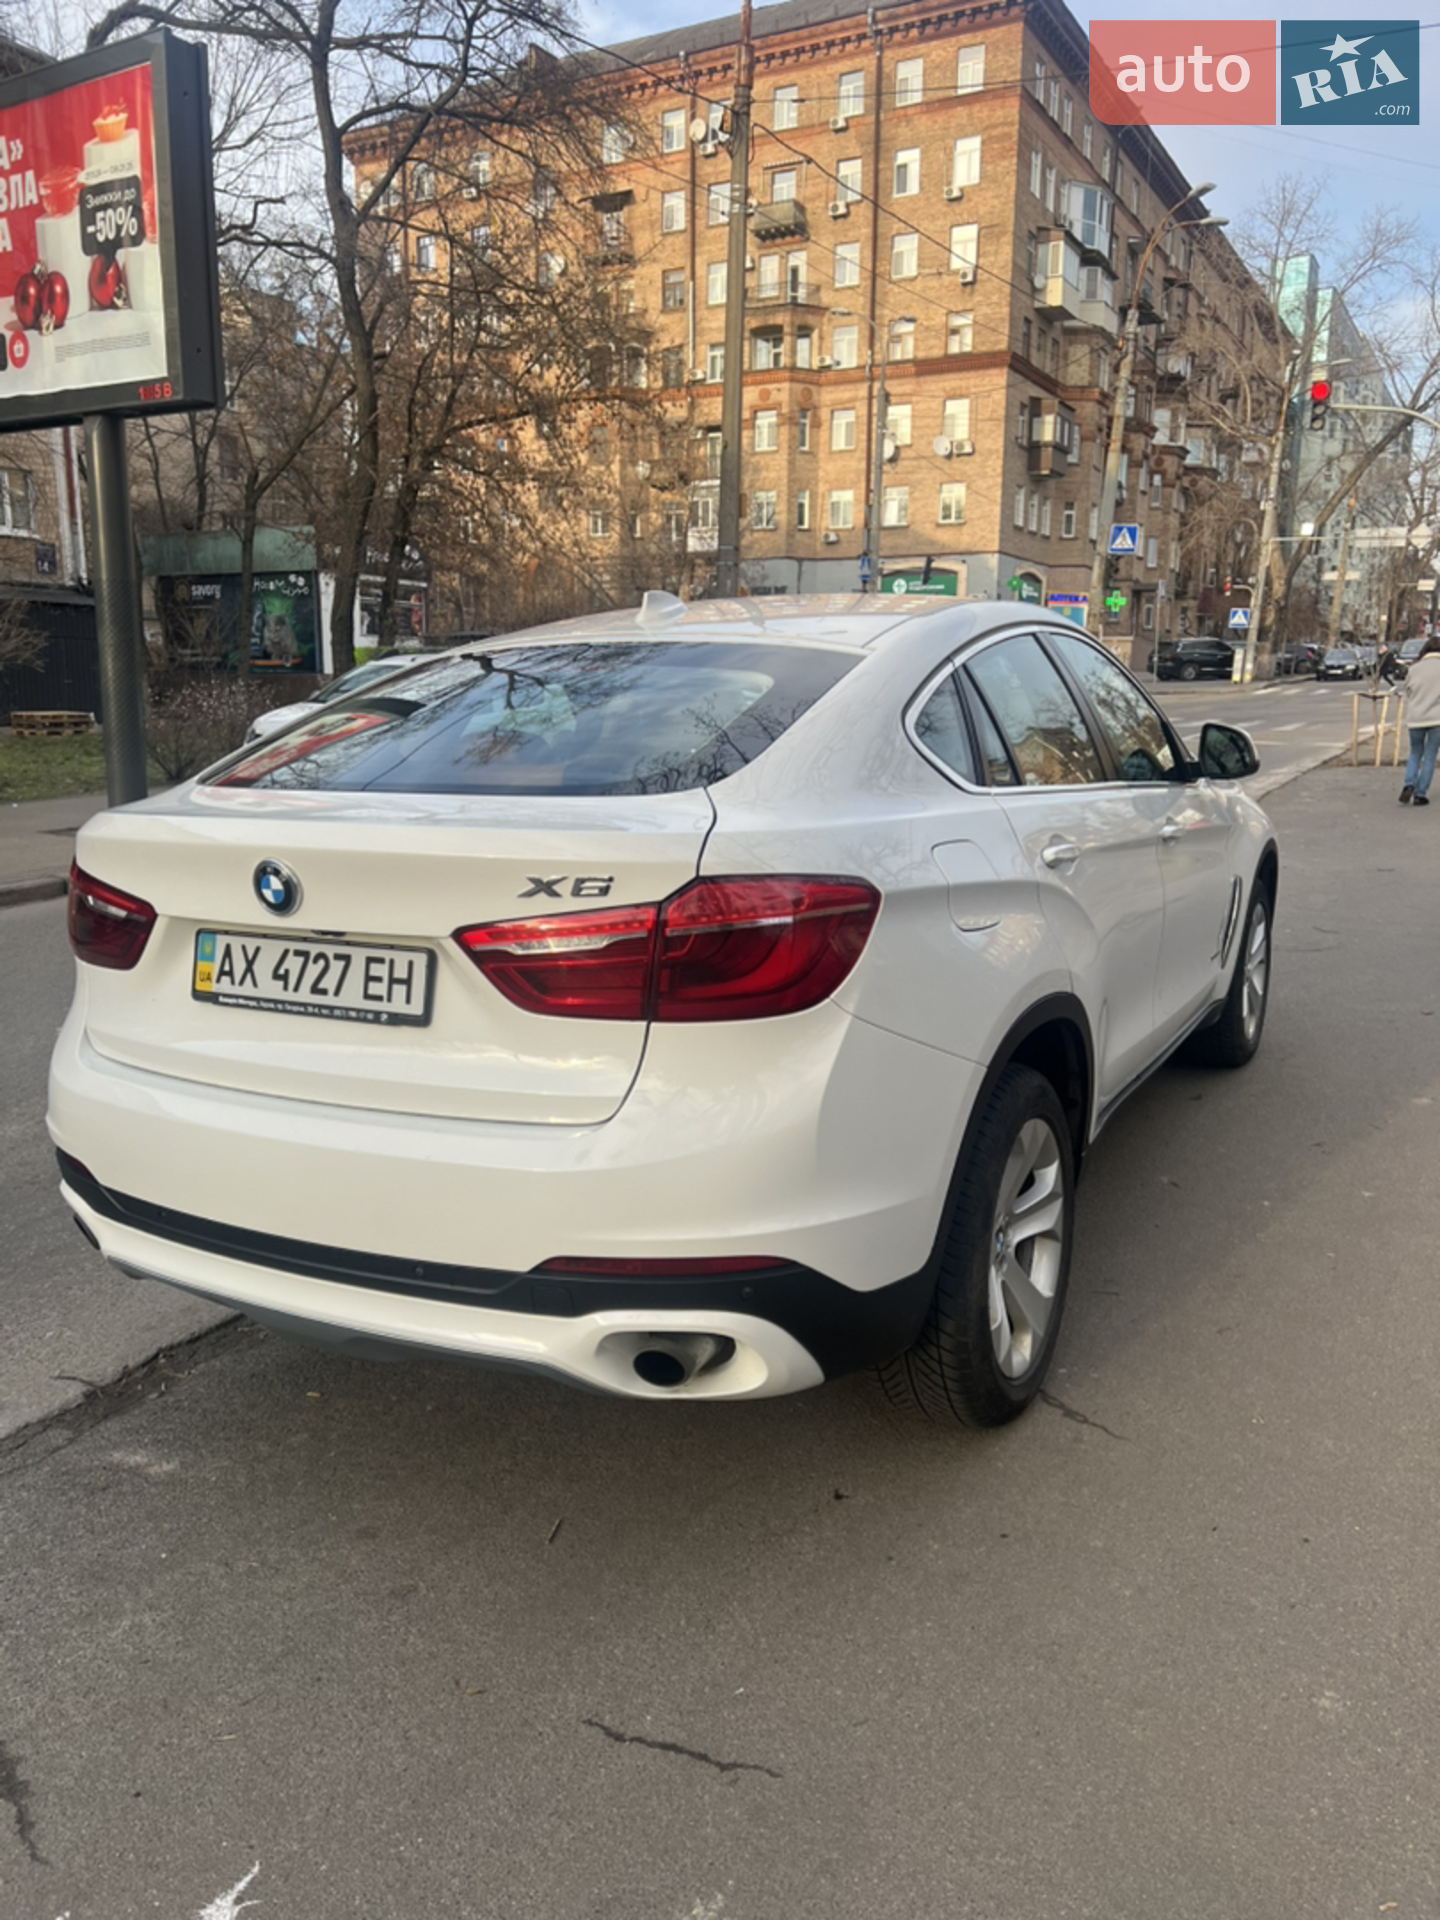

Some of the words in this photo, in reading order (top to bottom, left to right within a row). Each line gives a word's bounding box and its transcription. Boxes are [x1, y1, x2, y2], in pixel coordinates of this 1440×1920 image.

[87, 204, 138, 243] -50%
[517, 875, 615, 899] X6
[215, 942, 262, 989] AX
[271, 947, 353, 998] 4727
[362, 955, 415, 1006] EH
